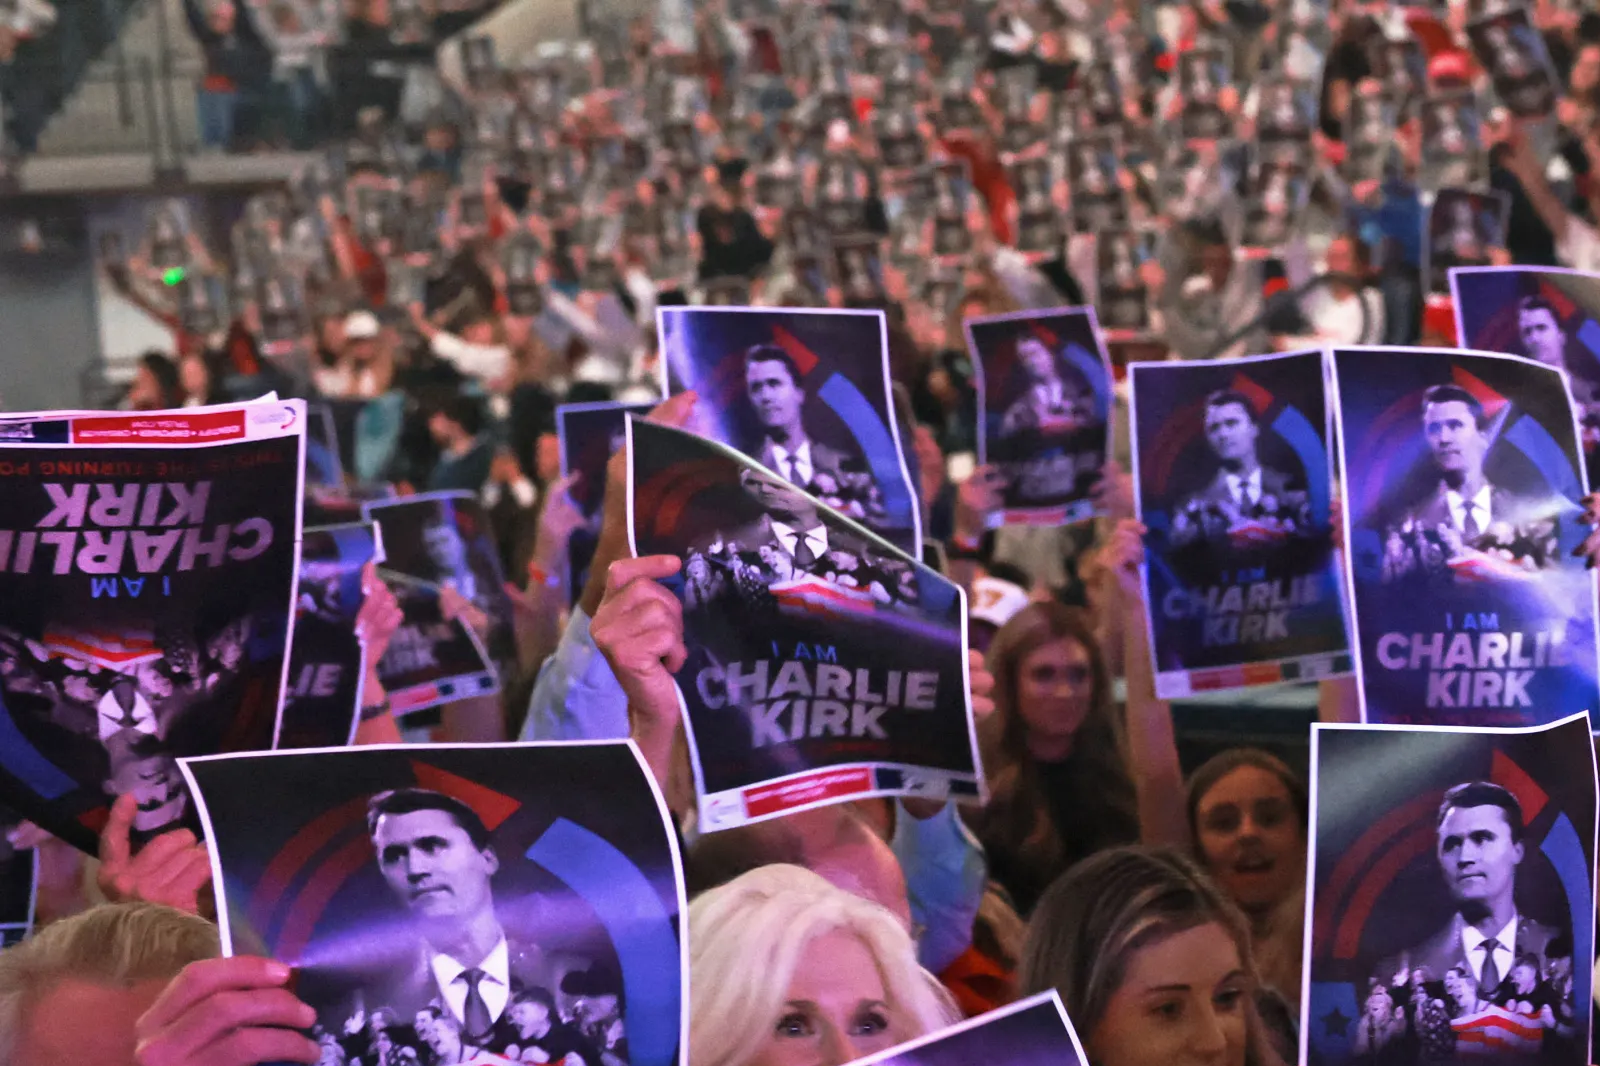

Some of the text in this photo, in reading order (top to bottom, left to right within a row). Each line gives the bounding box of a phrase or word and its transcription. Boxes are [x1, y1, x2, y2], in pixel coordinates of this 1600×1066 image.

[36, 481, 212, 528] KIRK
[91, 575, 171, 598] I AM
[1162, 573, 1321, 619] CHARLIE
[1203, 608, 1289, 647] KIRK
[1445, 612, 1500, 631] I AM
[771, 640, 838, 664] I AM
[696, 659, 940, 710] CHARLIE
[1425, 670, 1536, 708] KIRK
[751, 699, 890, 749] KIRK
